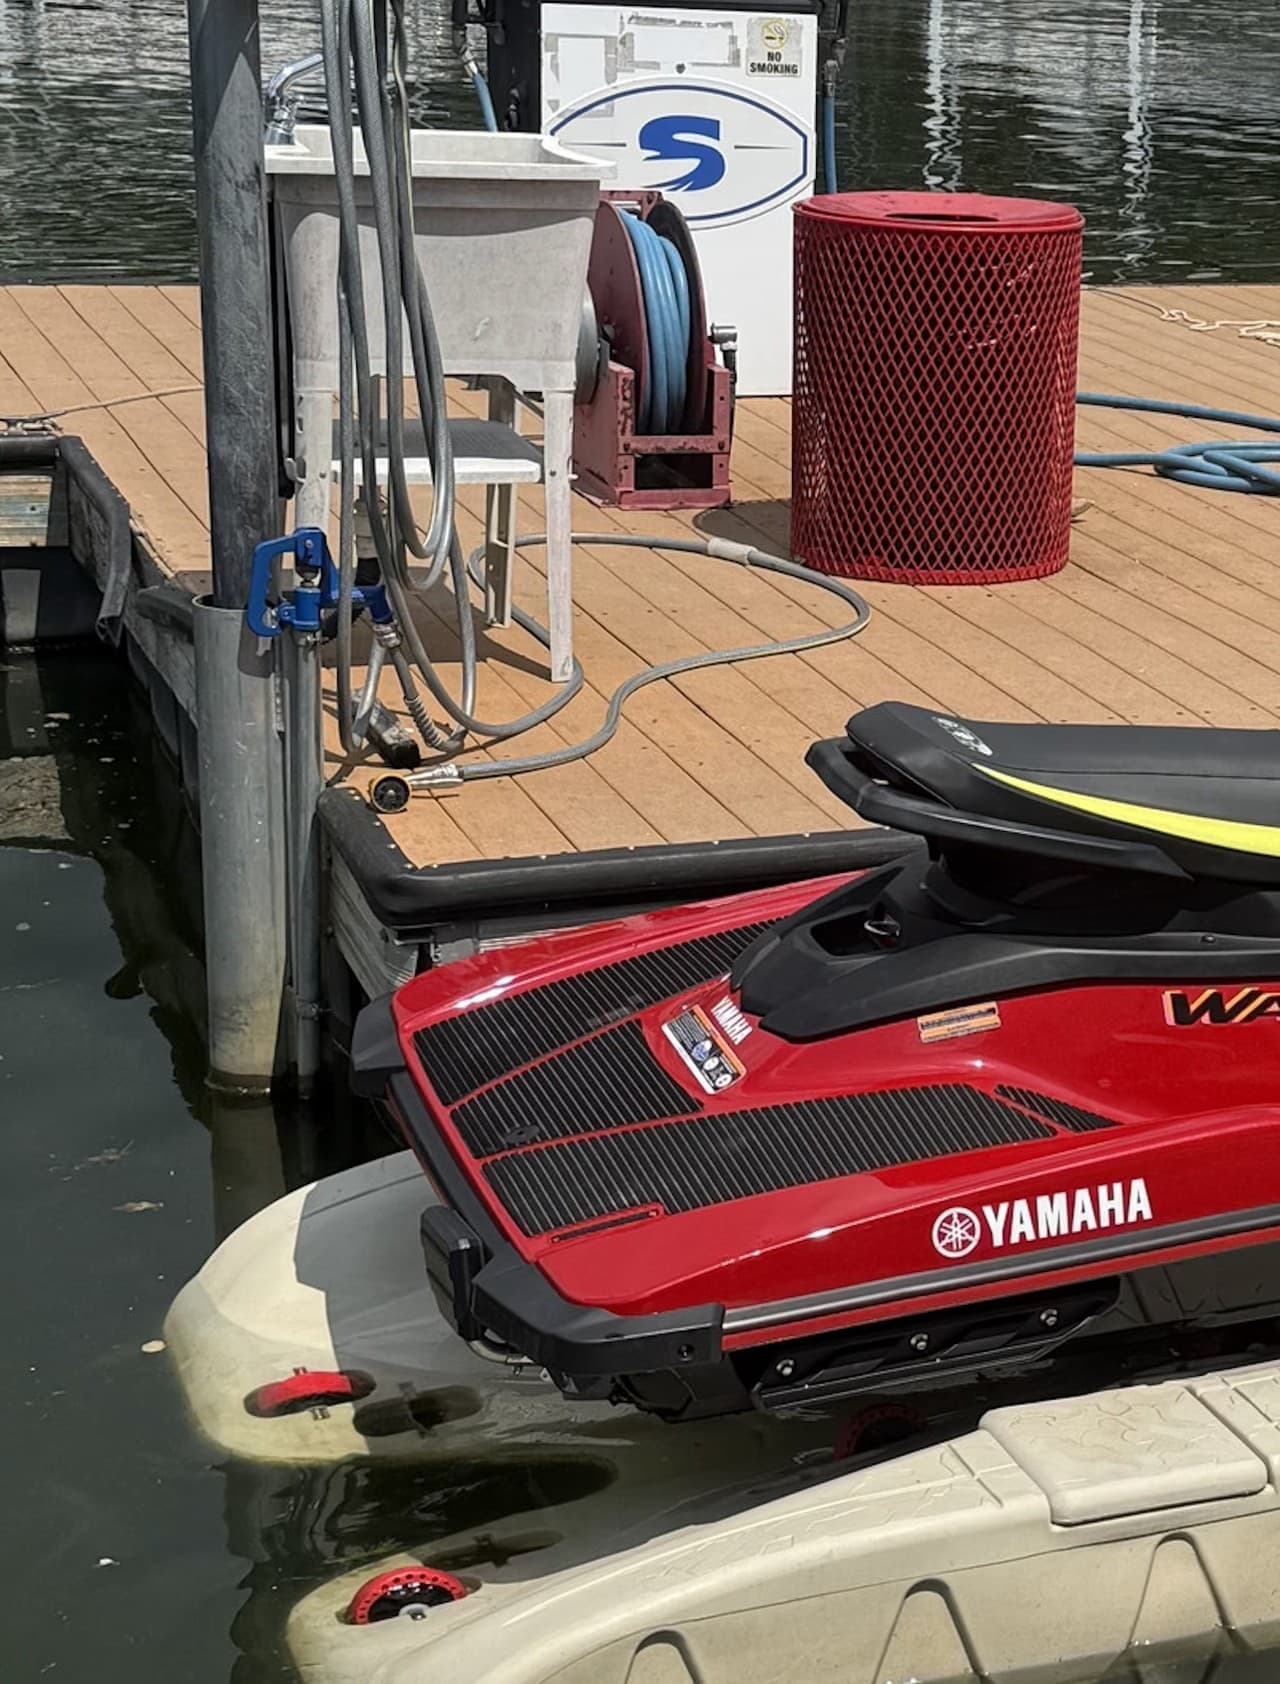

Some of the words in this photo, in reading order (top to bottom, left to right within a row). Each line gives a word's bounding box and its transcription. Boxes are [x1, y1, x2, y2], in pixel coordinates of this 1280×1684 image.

[749, 62, 799, 75] SMOKING
[767, 51, 782, 62] NO
[710, 995, 753, 1045] YAMAHA
[982, 1177, 1153, 1247] YAMAHA
